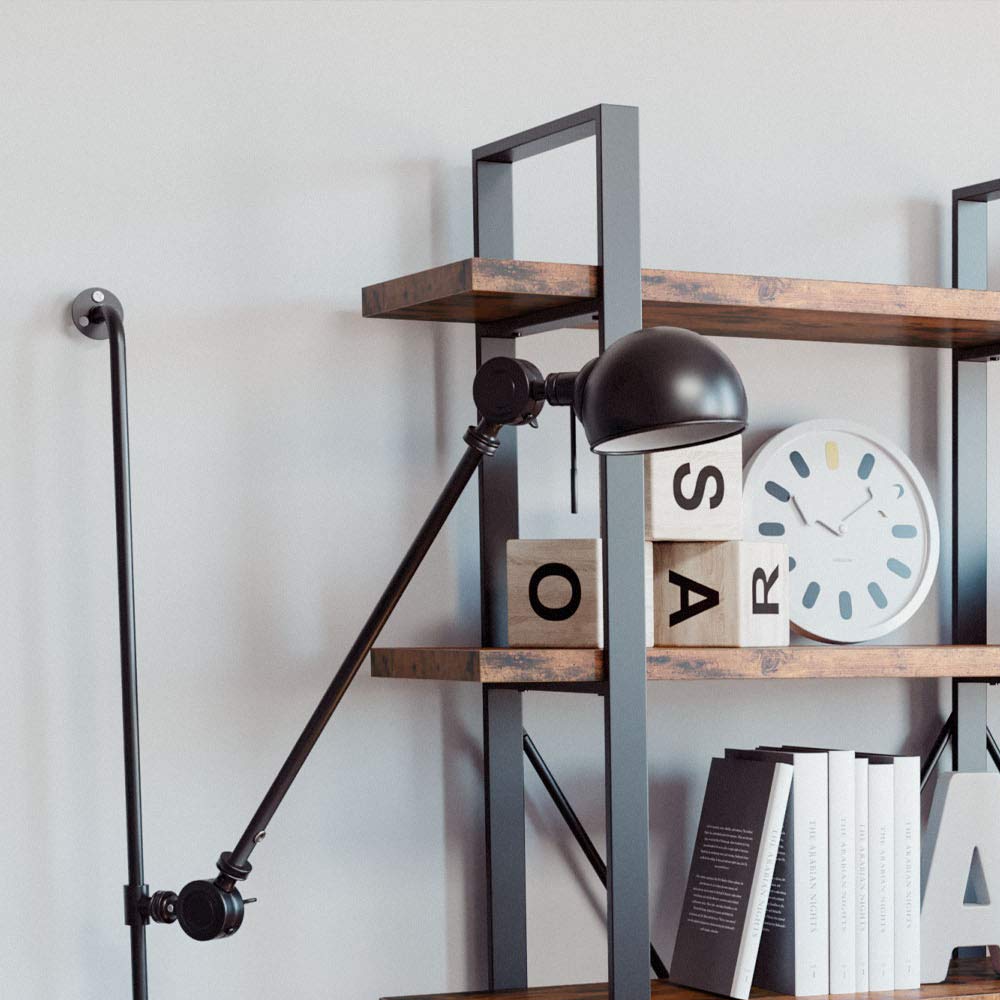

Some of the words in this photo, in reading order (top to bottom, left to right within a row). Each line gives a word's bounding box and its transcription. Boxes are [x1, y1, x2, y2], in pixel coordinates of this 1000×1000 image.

[672, 462, 725, 511] S
[529, 562, 581, 621] O
[668, 569, 720, 627] A
[751, 564, 780, 615] R
